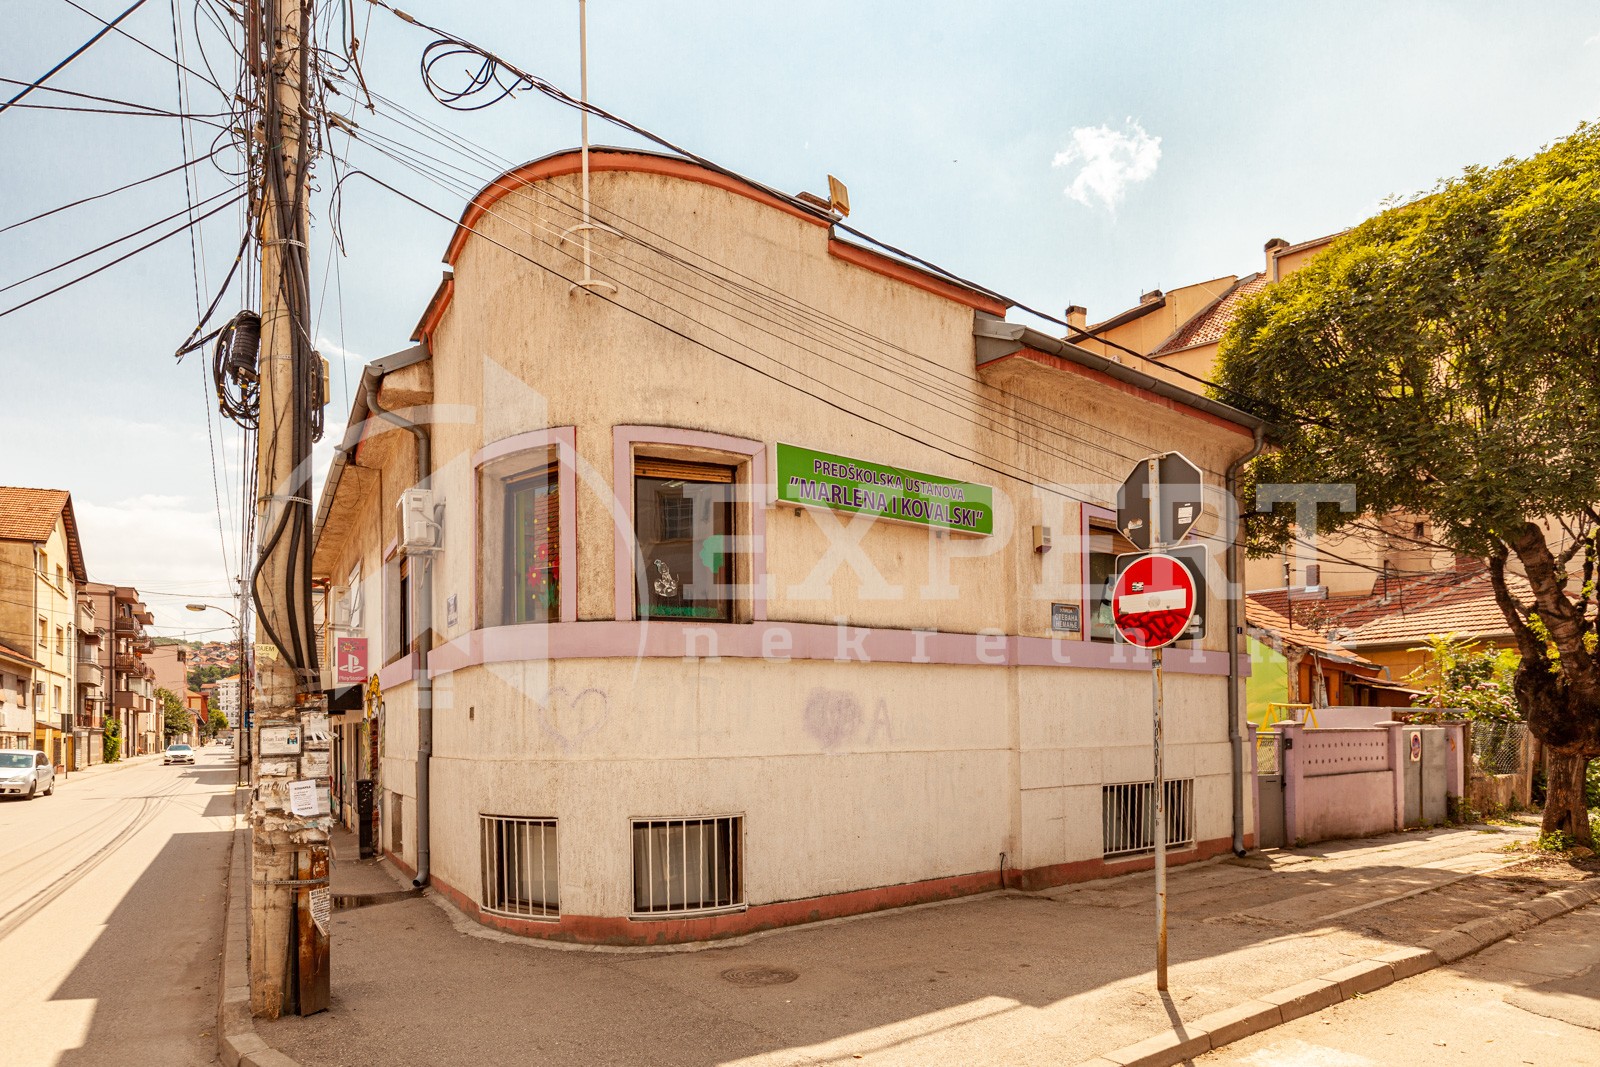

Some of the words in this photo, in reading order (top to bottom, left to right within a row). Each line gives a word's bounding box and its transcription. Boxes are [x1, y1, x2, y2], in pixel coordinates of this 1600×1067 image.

[813, 459, 903, 489] PREDŠKOLSKA
[905, 478, 965, 502] USTANOVA
[892, 495, 897, 514] I
